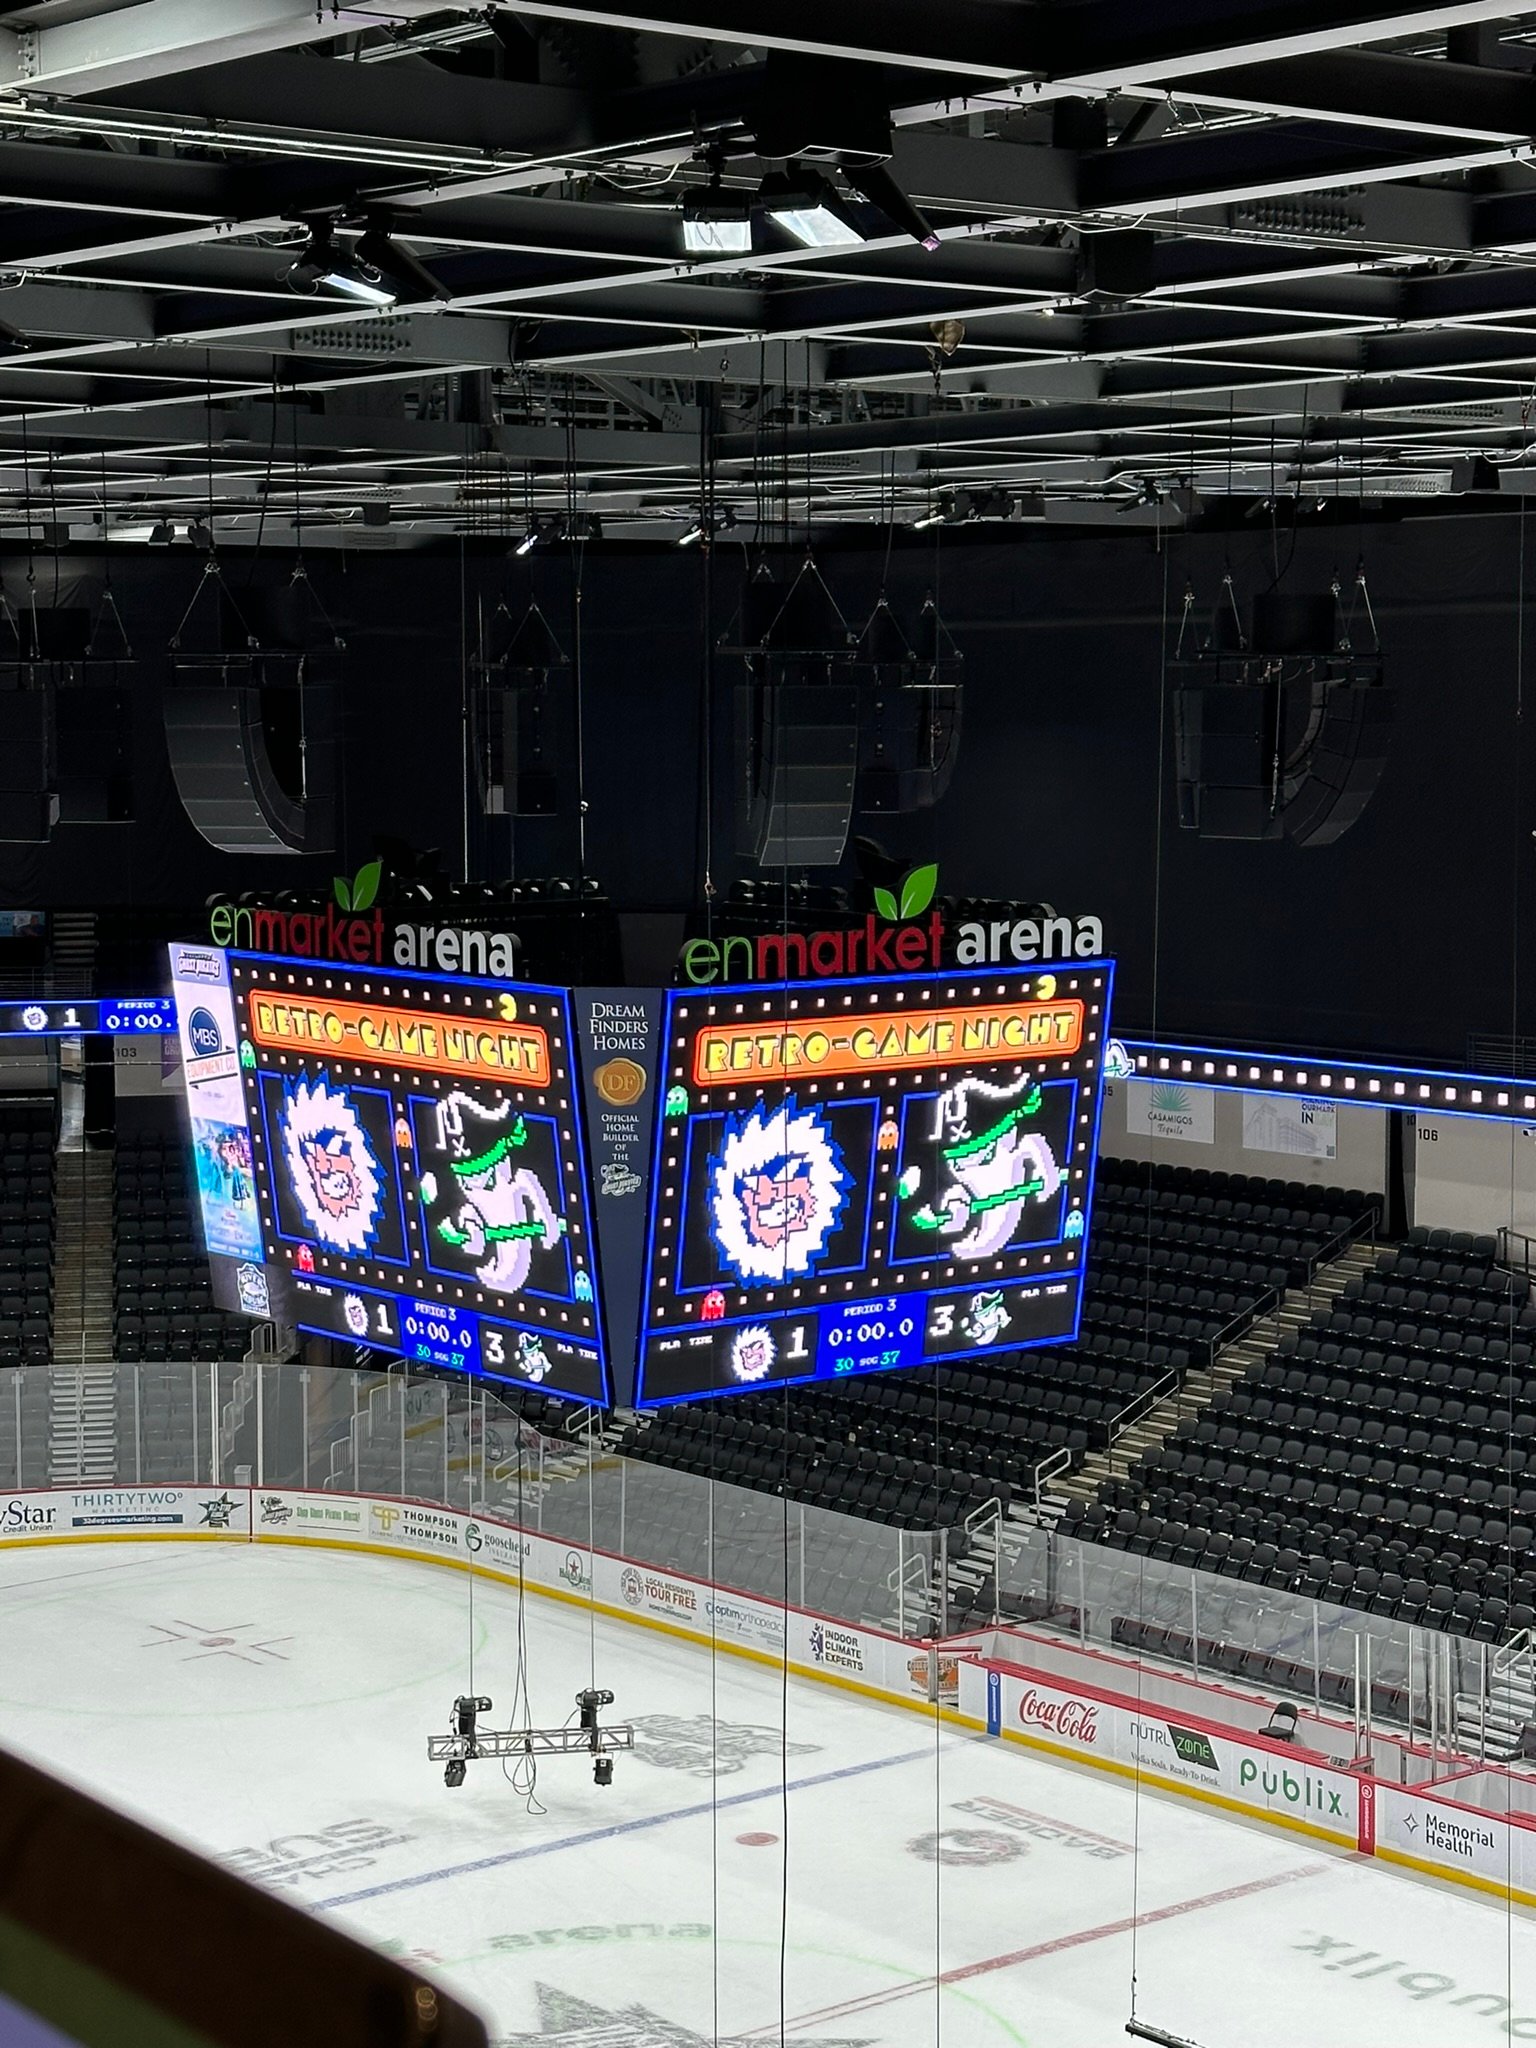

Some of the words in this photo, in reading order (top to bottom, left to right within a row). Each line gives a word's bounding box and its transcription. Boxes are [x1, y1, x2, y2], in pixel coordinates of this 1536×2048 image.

[210, 903, 383, 963] enmarket
[394, 923, 514, 978] arena
[686, 912, 943, 984] enmarket
[957, 916, 1102, 965] arena
[117, 1001, 157, 1010] PERIOD
[161, 1000, 171, 1010] 3
[63, 1008, 81, 1027] 1
[192, 1027, 218, 1047] MBS
[258, 1001, 438, 1060] RETRO-GAME
[443, 1029, 541, 1074] NIGHT
[706, 1021, 955, 1073] RETRO-GAME
[963, 1012, 1075, 1053] NIGHT
[115, 1047, 137, 1058] 103
[606, 1074, 636, 1092] DF
[1147, 1111, 1193, 1126] CASAMIGOS
[1302, 1112, 1313, 1124] IN
[1157, 1123, 1183, 1136] Tequila
[1418, 1128, 1439, 1142] 106
[612, 1152, 629, 1161] THE
[414, 1302, 447, 1319] PERIOD
[448, 1308, 457, 1322] 3
[843, 1303, 884, 1319] PERIOD
[886, 1298, 898, 1313] 3
[376, 1303, 394, 1336] 1
[929, 1305, 955, 1337] 3
[406, 1316, 473, 1349] 0:00.0
[786, 1325, 809, 1360] 1
[828, 1317, 914, 1348] 0:00.0
[416, 1343, 431, 1358] 30
[451, 1353, 466, 1367] 37
[485, 1330, 505, 1365] 3
[835, 1356, 855, 1372] 30
[880, 1350, 901, 1366] 37
[92, 1506, 161, 1514] MARKETING
[403, 1510, 458, 1529] THOMPSON
[3, 1526, 27, 1534] Credit
[29, 1524, 53, 1532] Union
[403, 1525, 458, 1544] THOMPSON
[644, 1584, 671, 1603] TOUR
[673, 1593, 697, 1611] FREE
[664, 1583, 695, 1598] RESIDENTS
[825, 1629, 858, 1647] INDOOR
[825, 1641, 862, 1659] CLIMATE
[825, 1653, 864, 1671] EXPERTS
[1019, 1689, 1099, 1743] Coca-Cola
[1176, 1735, 1210, 1760] ZONE
[1240, 1758, 1343, 1817] Publix
[1425, 1813, 1495, 1849] Memorial
[1425, 1828, 1473, 1858] Health
